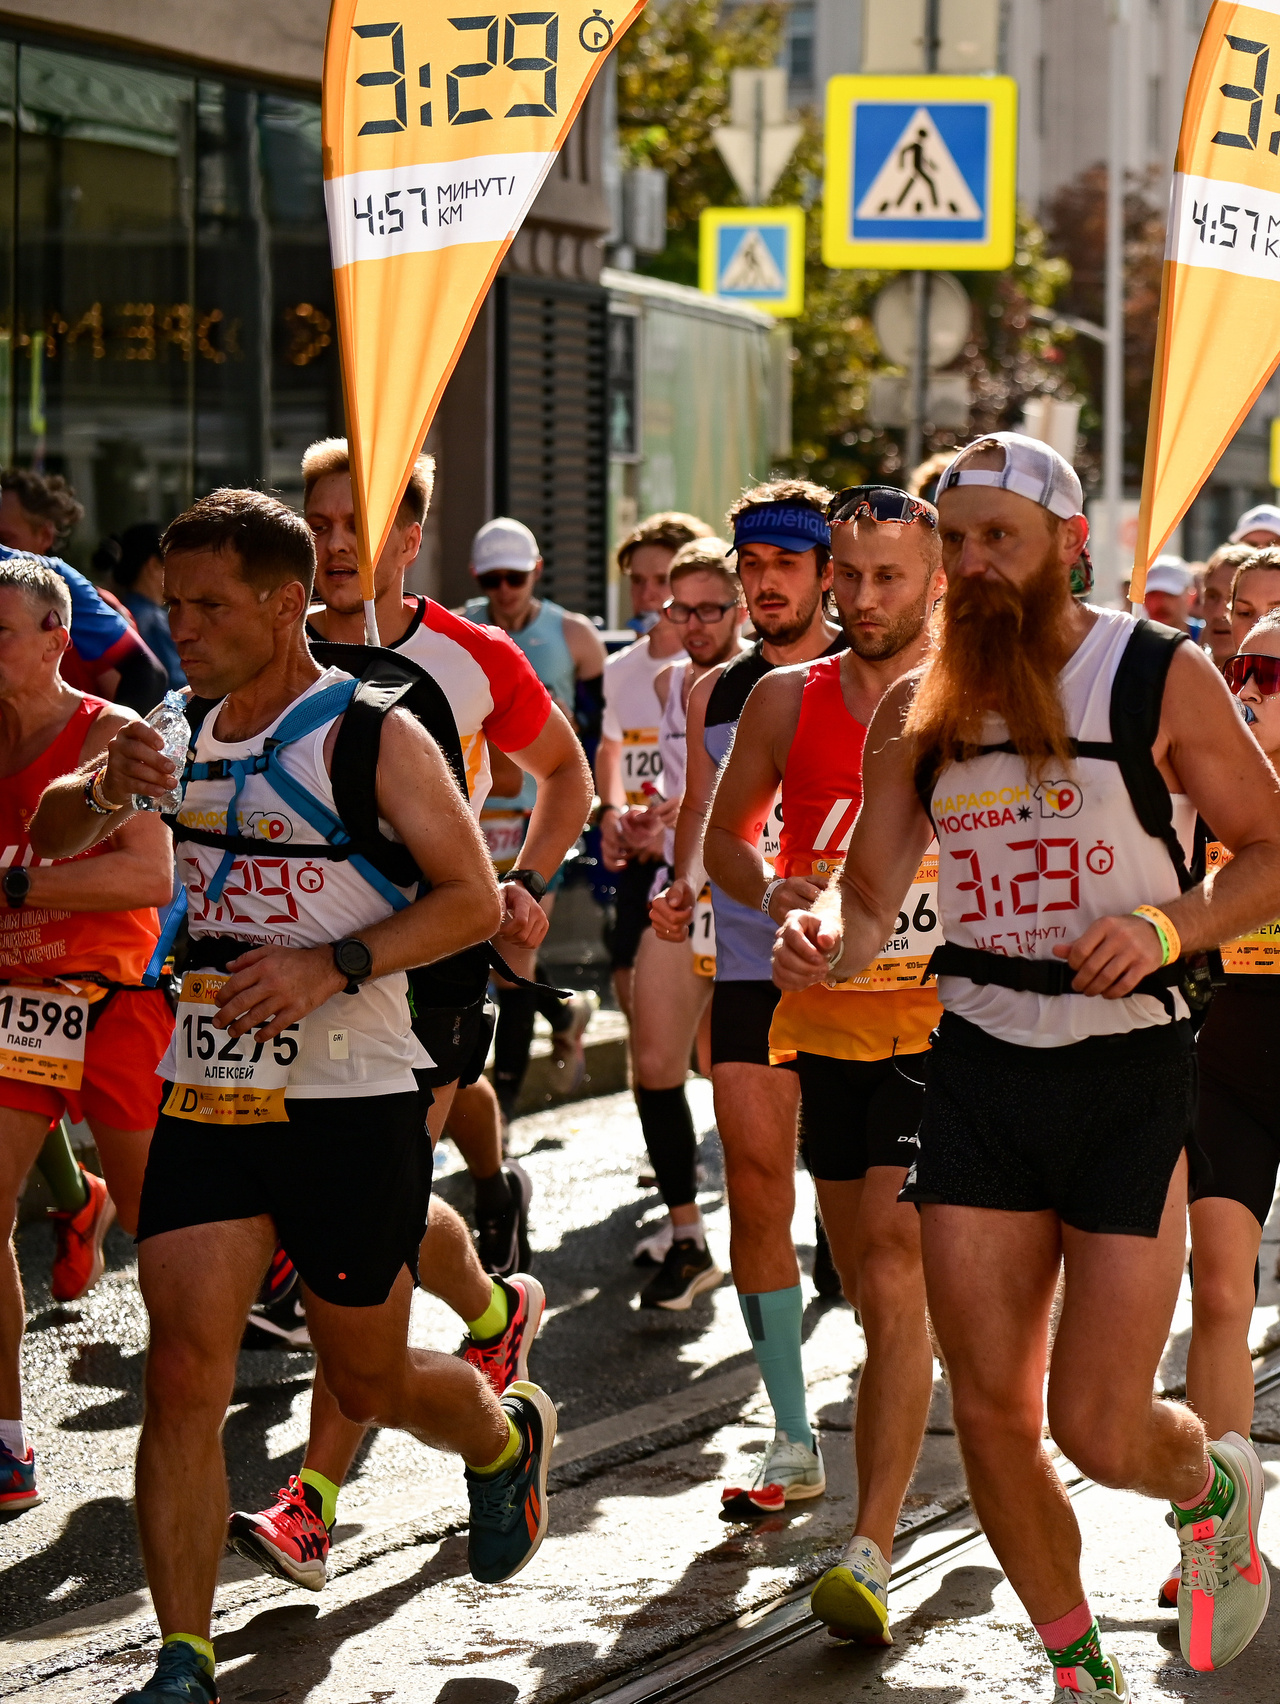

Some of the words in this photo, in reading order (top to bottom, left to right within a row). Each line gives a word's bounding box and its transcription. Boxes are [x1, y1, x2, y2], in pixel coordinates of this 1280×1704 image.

[351, 12, 559, 137] 3:29
[353, 187, 428, 236] 4:57
[437, 175, 516, 205] МИНУТ/
[438, 204, 463, 227] КМ
[1192, 199, 1260, 252] 4:57
[933, 784, 1030, 815] МАРАФОН
[937, 807, 1017, 834] МОСКВА
[950, 838, 1080, 923] 3:29
[6, 1033, 42, 1049] ПАВЕЛ
[182, 1014, 300, 1066] 15275
[204, 1065, 255, 1080] АЛЕКСЕЙ
[180, 1088, 198, 1113] D
